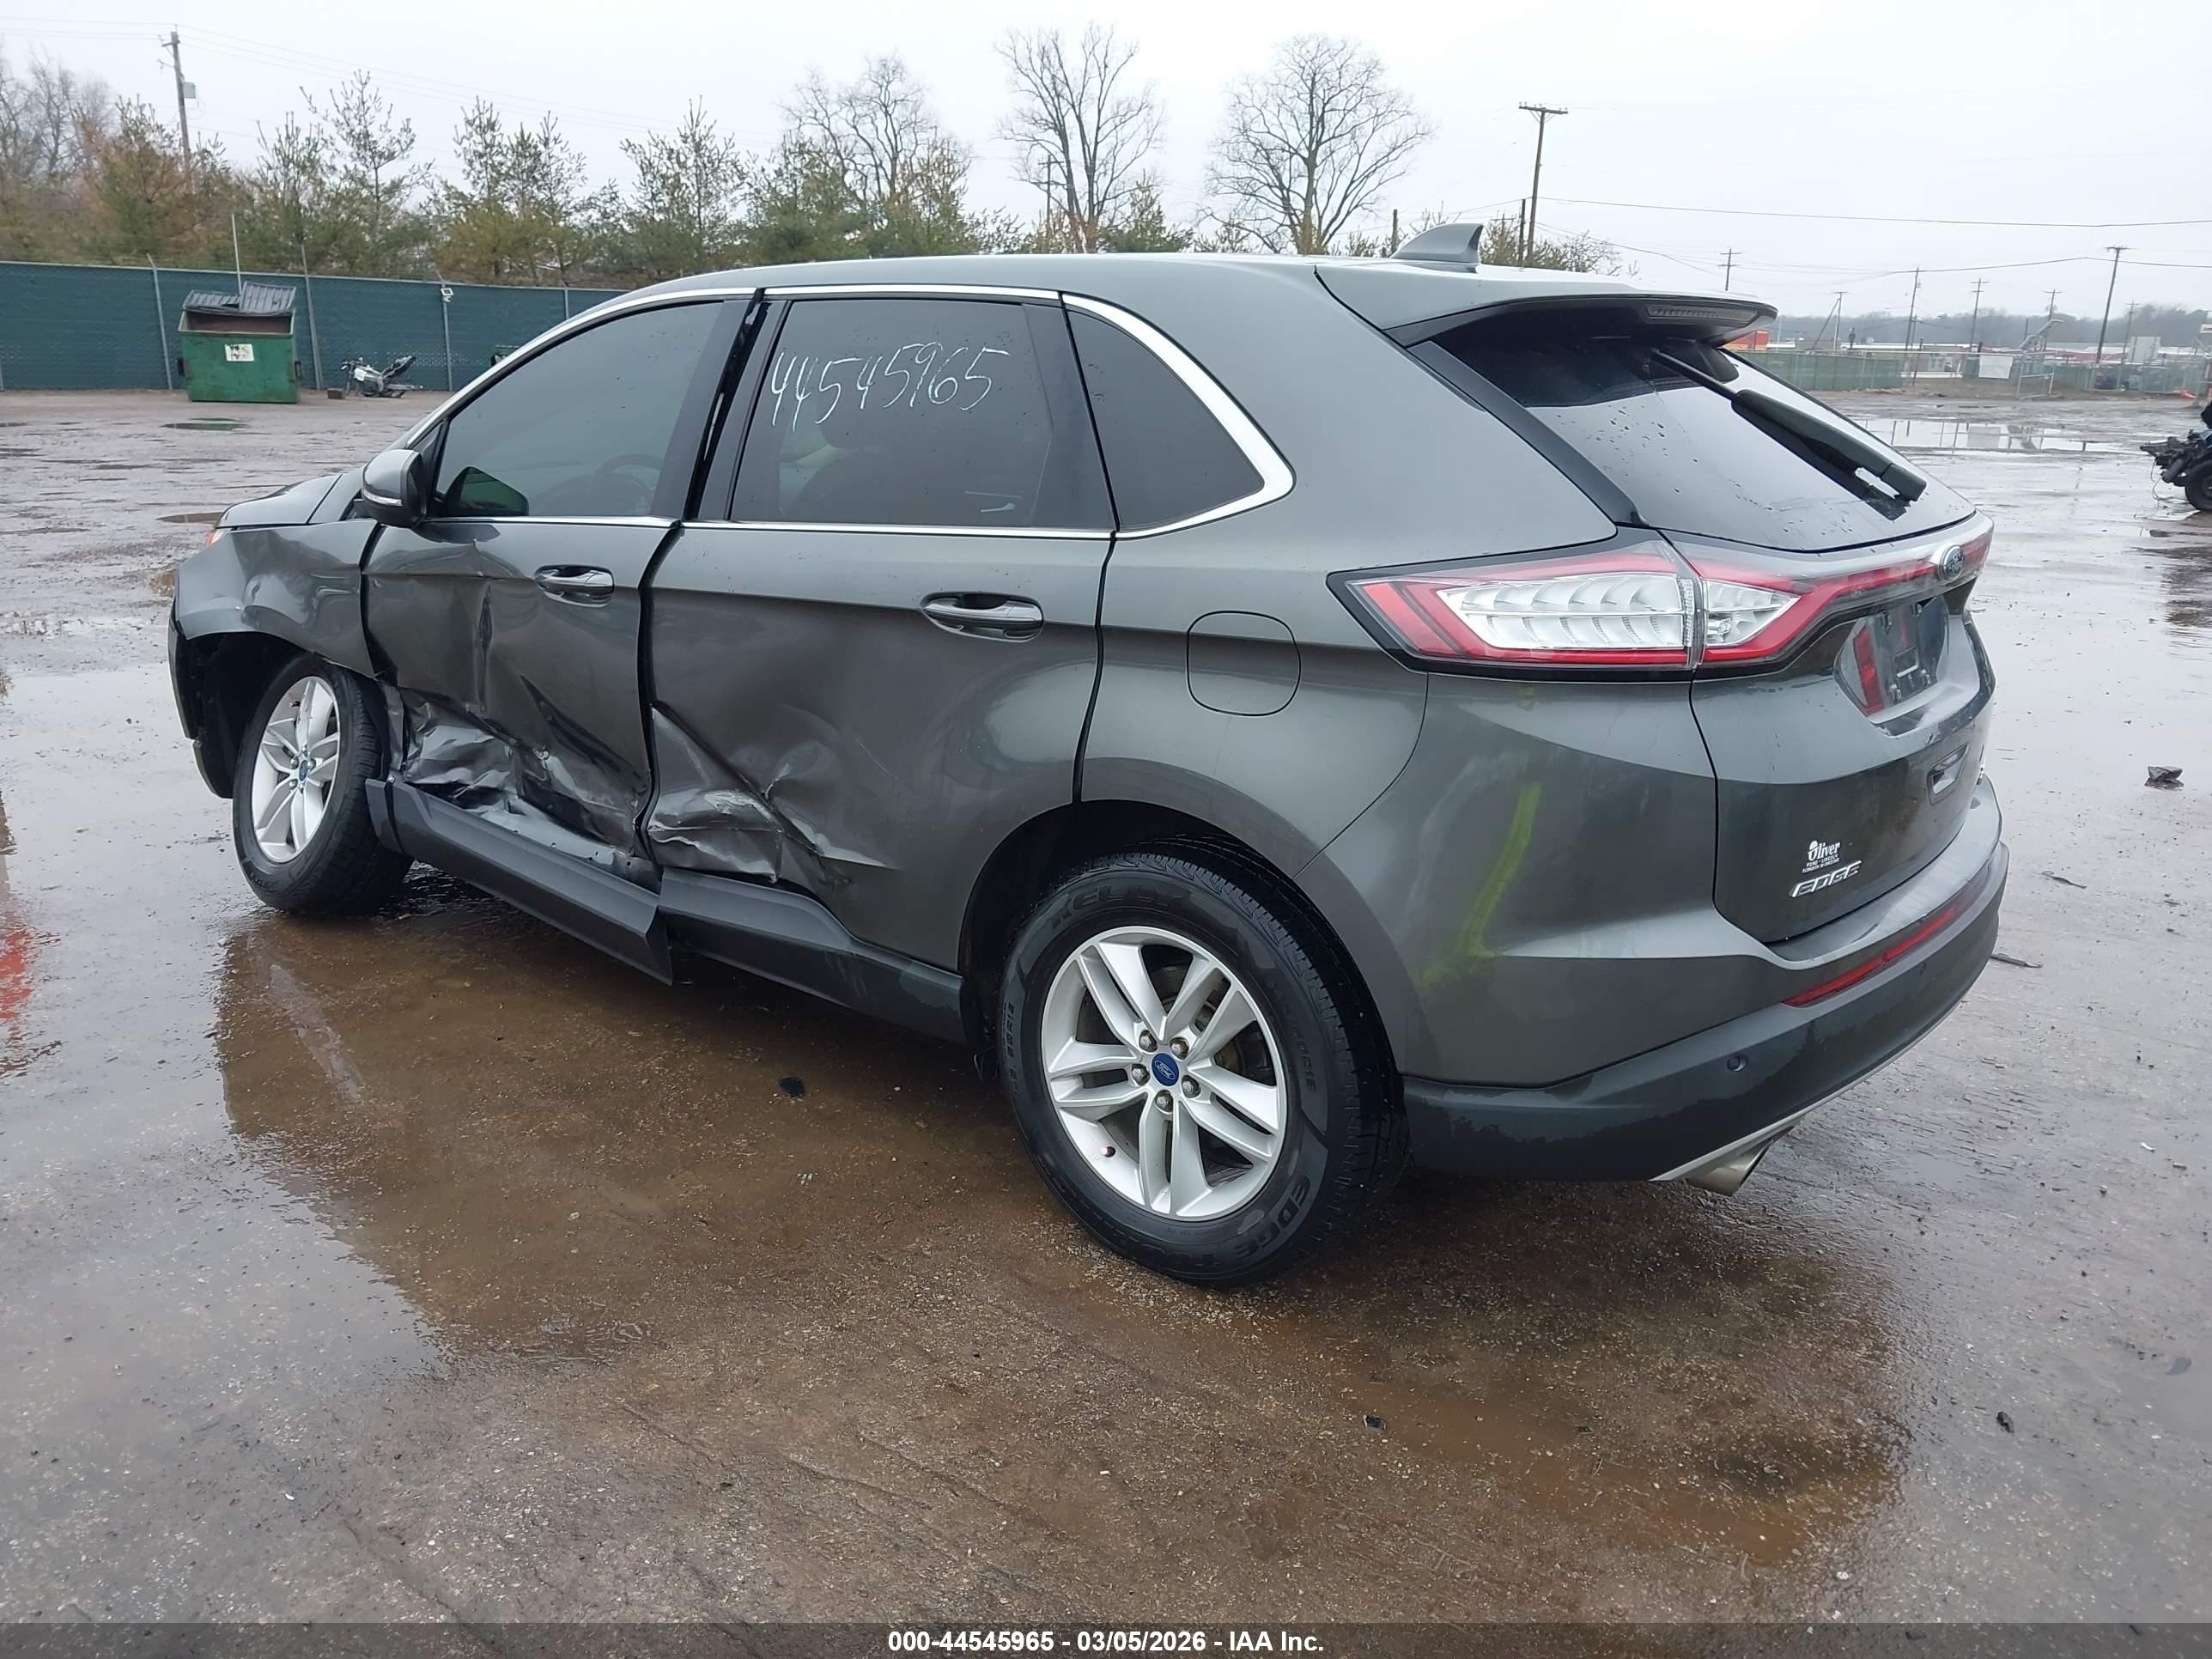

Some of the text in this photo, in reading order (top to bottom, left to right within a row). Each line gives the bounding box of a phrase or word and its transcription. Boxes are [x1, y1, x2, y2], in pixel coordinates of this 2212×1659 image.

[771, 342, 1011, 432] 44545965
[1808, 841, 1840, 861] Oliver
[1790, 860, 1862, 897] EDGE
